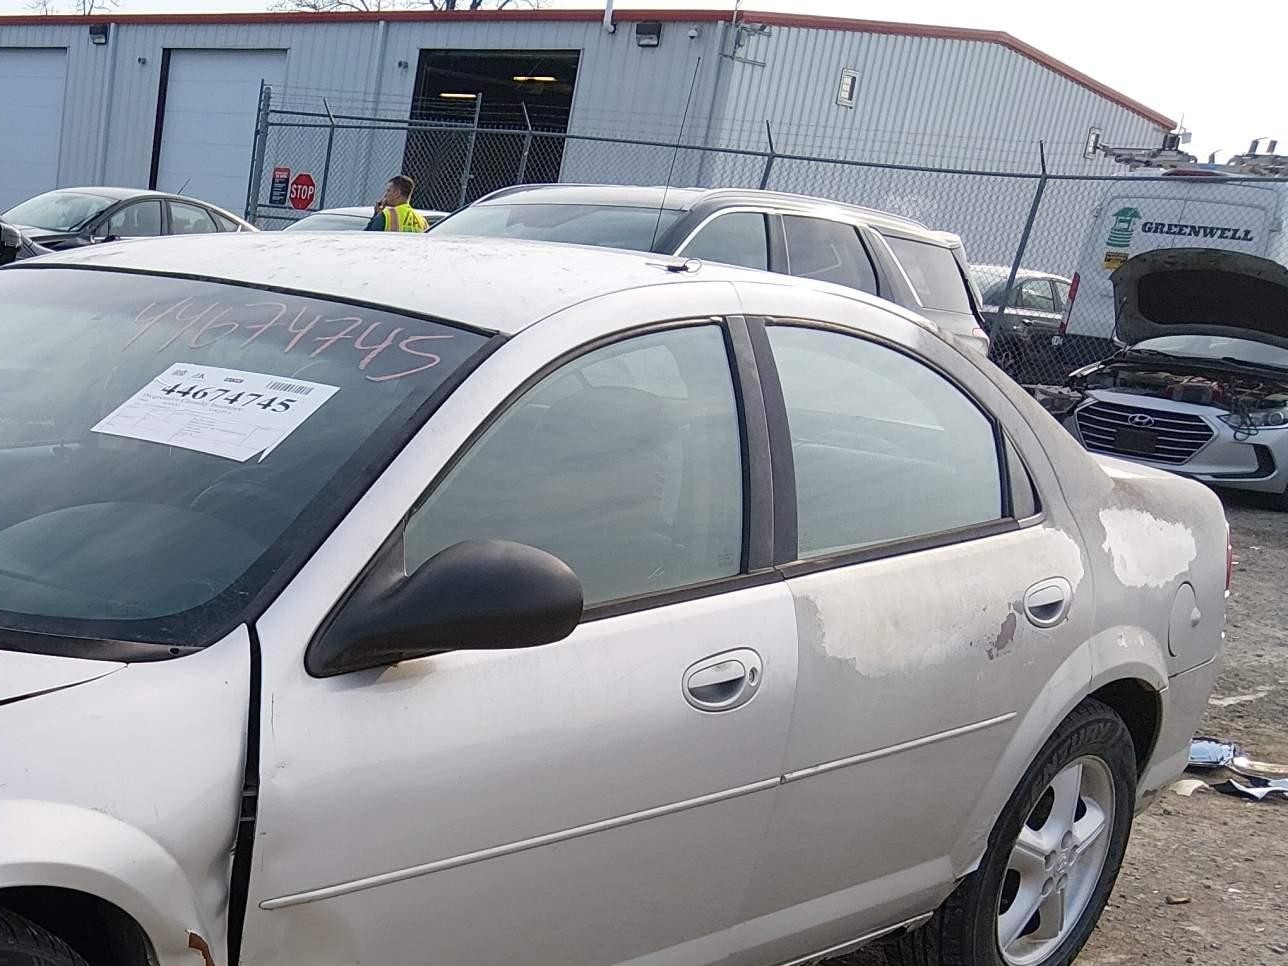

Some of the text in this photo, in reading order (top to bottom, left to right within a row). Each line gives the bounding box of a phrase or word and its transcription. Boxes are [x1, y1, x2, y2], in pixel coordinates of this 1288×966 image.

[290, 184, 315, 200] STOP
[1141, 221, 1254, 242] GREENWELL
[121, 296, 454, 382] 44674745
[161, 382, 298, 414] 44674745
